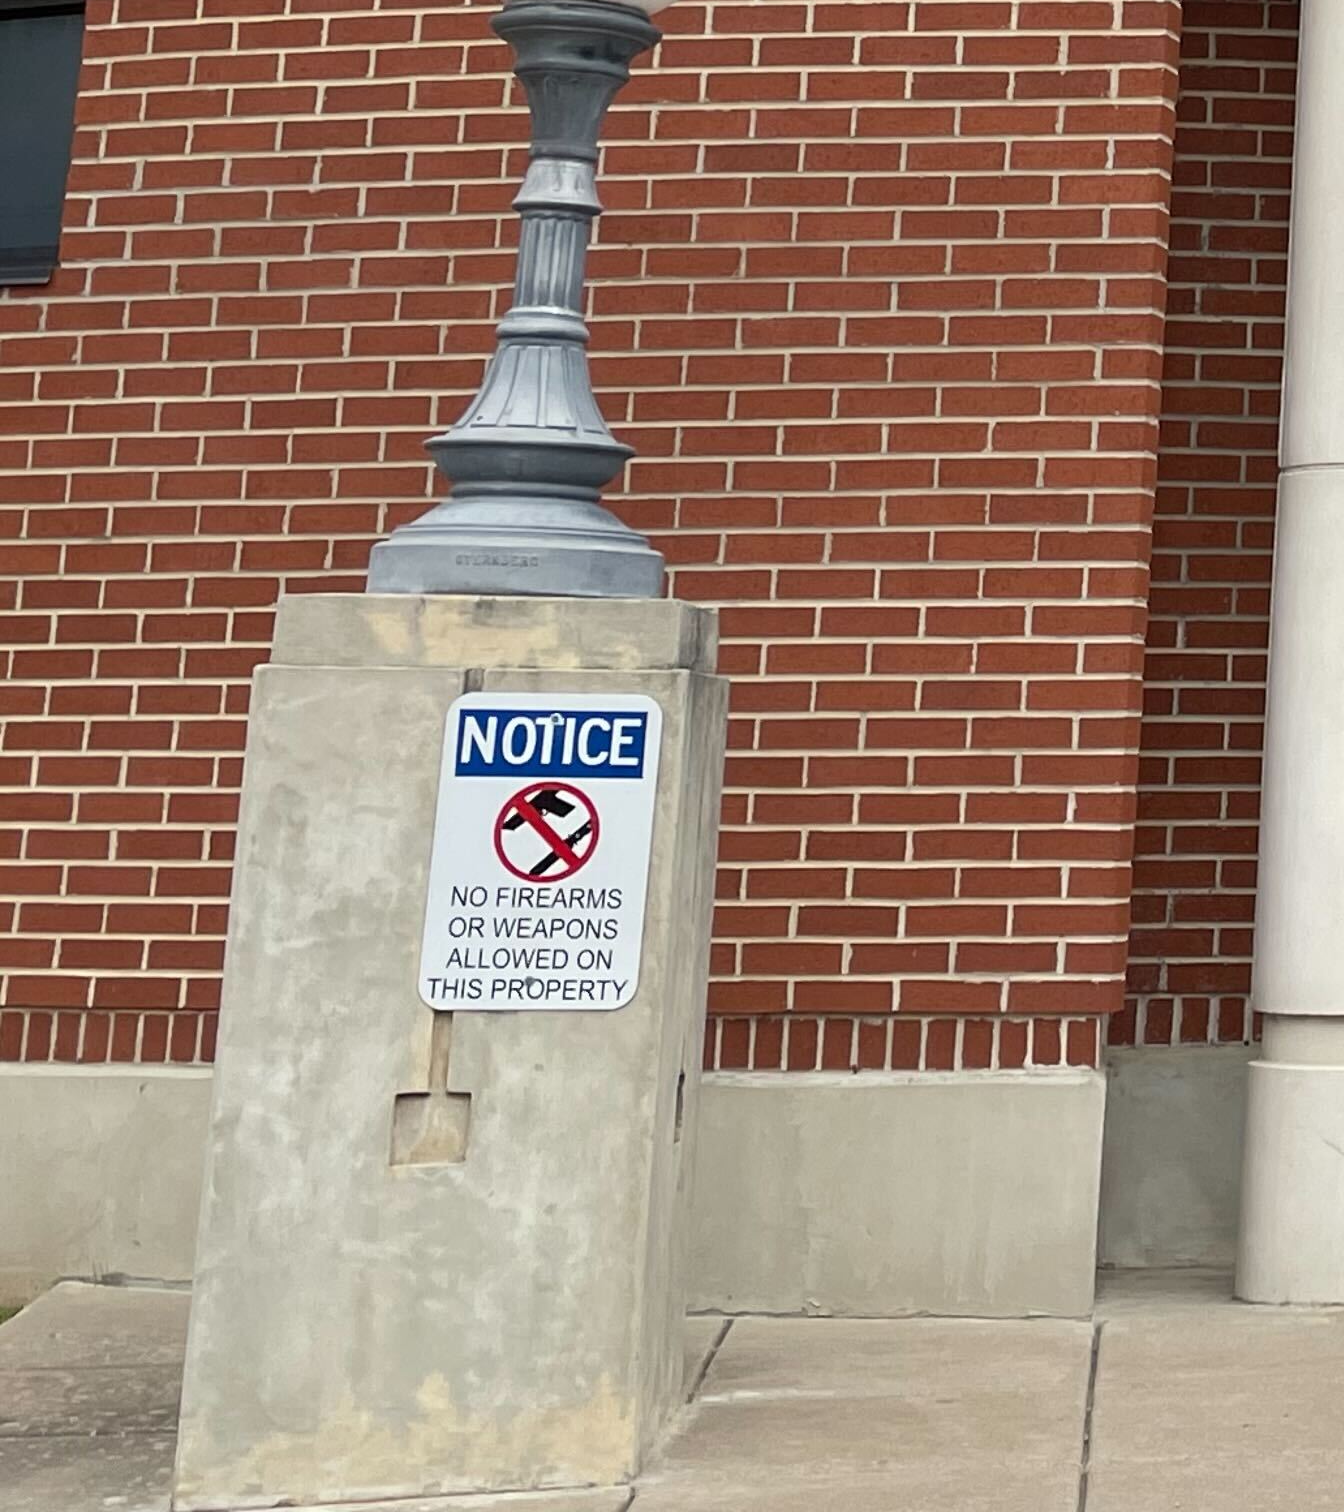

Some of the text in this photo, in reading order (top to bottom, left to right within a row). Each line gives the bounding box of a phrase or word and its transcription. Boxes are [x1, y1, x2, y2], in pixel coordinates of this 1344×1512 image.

[460, 716, 642, 766] NOTICE
[451, 886, 622, 909] NO FIREARMS
[449, 917, 618, 939] OR WEAPONS
[446, 948, 612, 970] ALLOWED ON
[427, 978, 628, 1001] THIS PROPERTY
